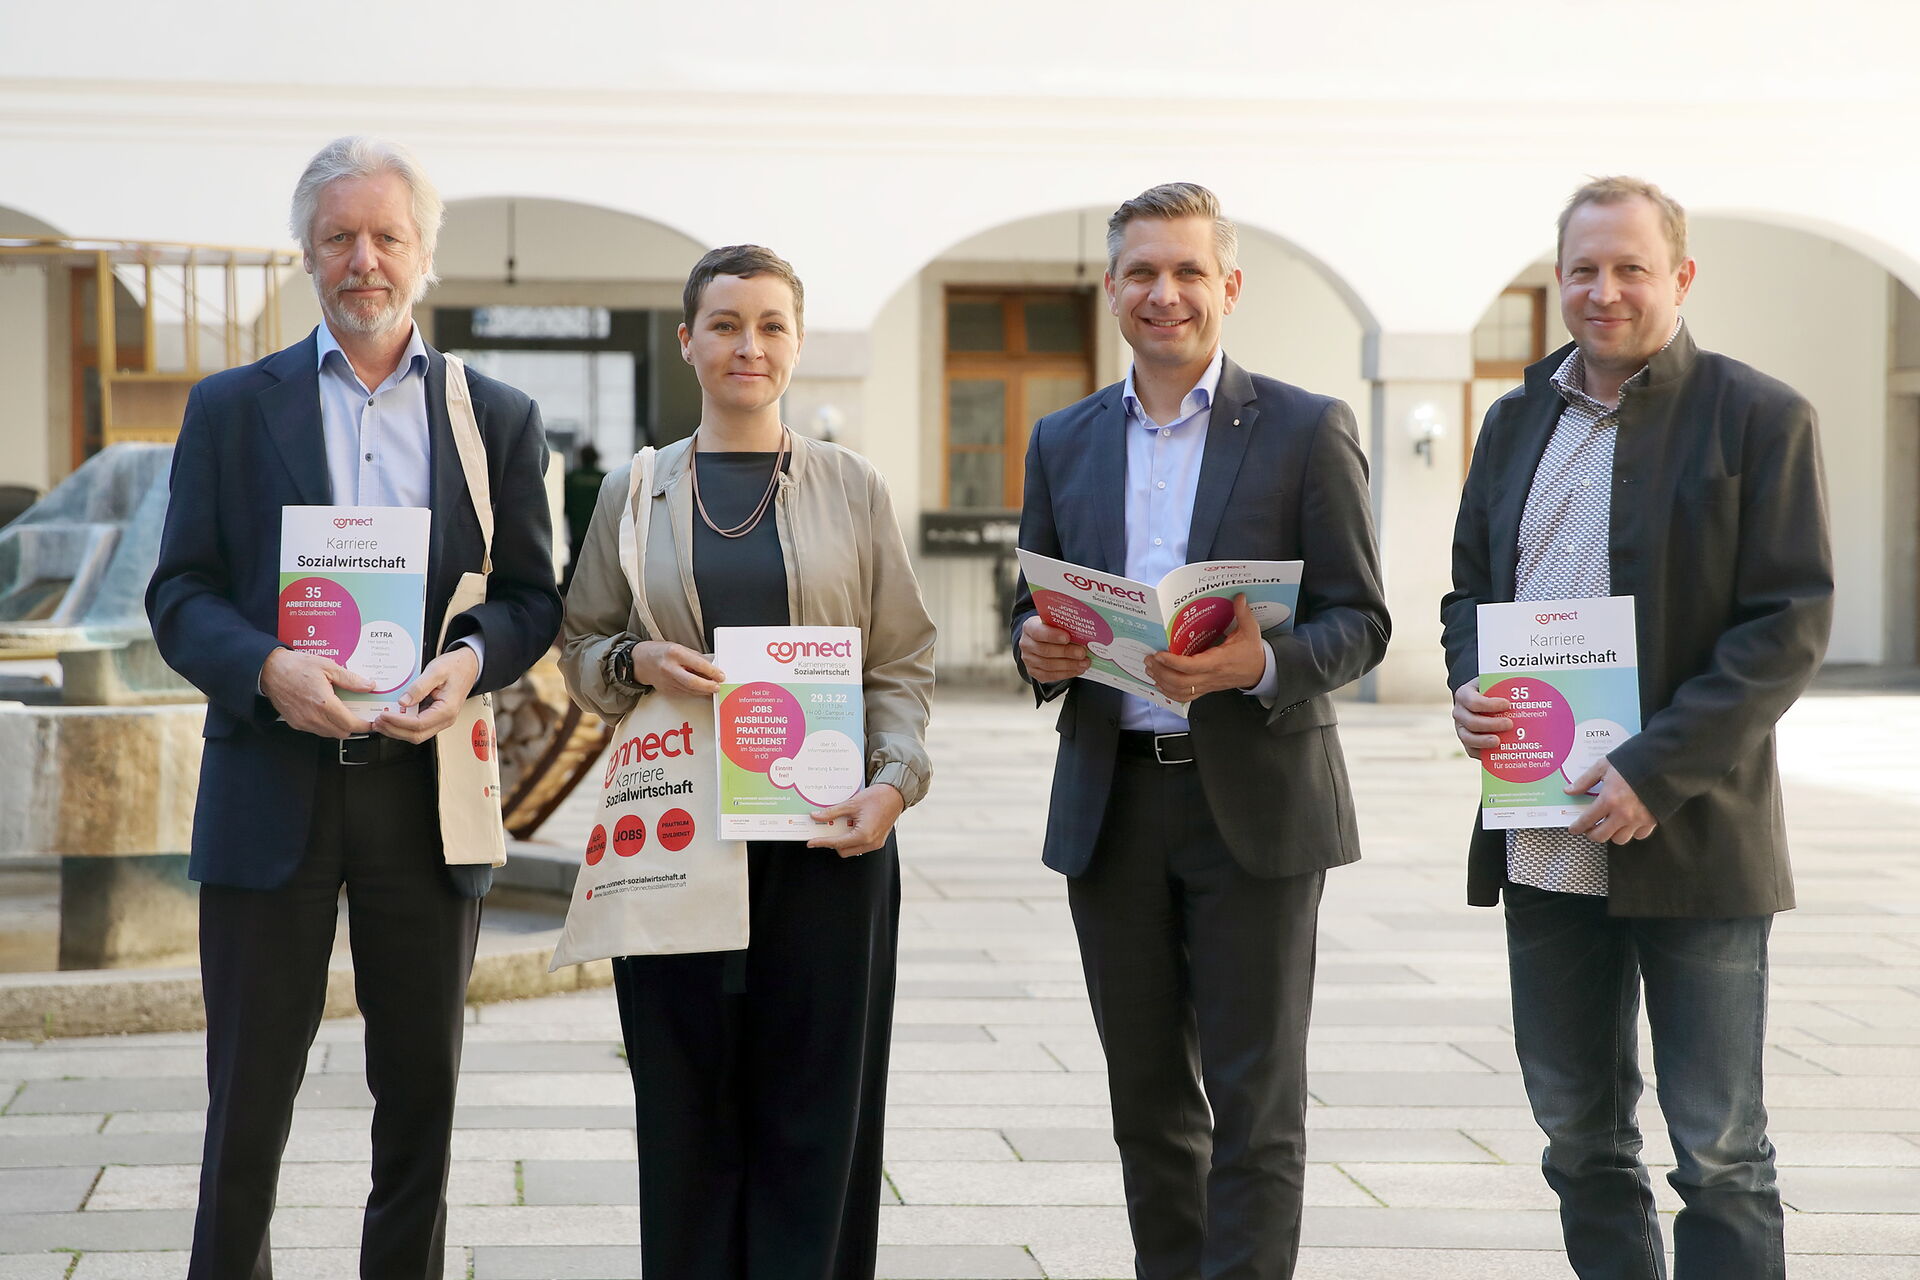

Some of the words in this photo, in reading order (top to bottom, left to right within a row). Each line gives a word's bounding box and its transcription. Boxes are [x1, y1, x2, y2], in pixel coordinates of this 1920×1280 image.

[333, 517, 373, 528] connect
[326, 537, 378, 550] Karriere
[297, 555, 406, 569] Sozialwirtschaft
[1198, 572, 1252, 584] Karriere
[305, 586, 321, 598] 35
[1063, 572, 1146, 604] connect
[1173, 577, 1281, 608] Sozialwirtschaft
[1183, 605, 1197, 621] 35
[1535, 611, 1578, 625] connect
[307, 625, 315, 637] 9
[293, 639, 330, 647] BILDUNGS-
[1530, 632, 1585, 647] Karriere
[766, 640, 852, 664] connect
[1499, 650, 1617, 667] Sozialwirtschaft
[794, 668, 850, 676] Sozialwirtschaft
[810, 693, 848, 703] 29.3.22
[1510, 687, 1529, 700] 35
[750, 706, 773, 714] JOBS
[1504, 711, 1547, 719] Sozialbereich
[734, 716, 788, 724] AUSBILDUNG
[736, 727, 786, 735] PRAKTIKUM
[1516, 728, 1525, 740] 9
[1585, 730, 1610, 738] EXTRA
[736, 737, 787, 745] ZIVILDIENST
[1500, 742, 1543, 750] BILDUNGS-
[1490, 752, 1554, 761] EINRICHTUNGEN
[1504, 761, 1528, 769] soziale
[1529, 760, 1550, 768] Berufe
[615, 766, 664, 789] Karriere
[605, 779, 694, 808] Sozialwirtschaft
[615, 829, 643, 842] JOBS
[595, 873, 687, 891] www.connect-sozialwirtschaft.at
